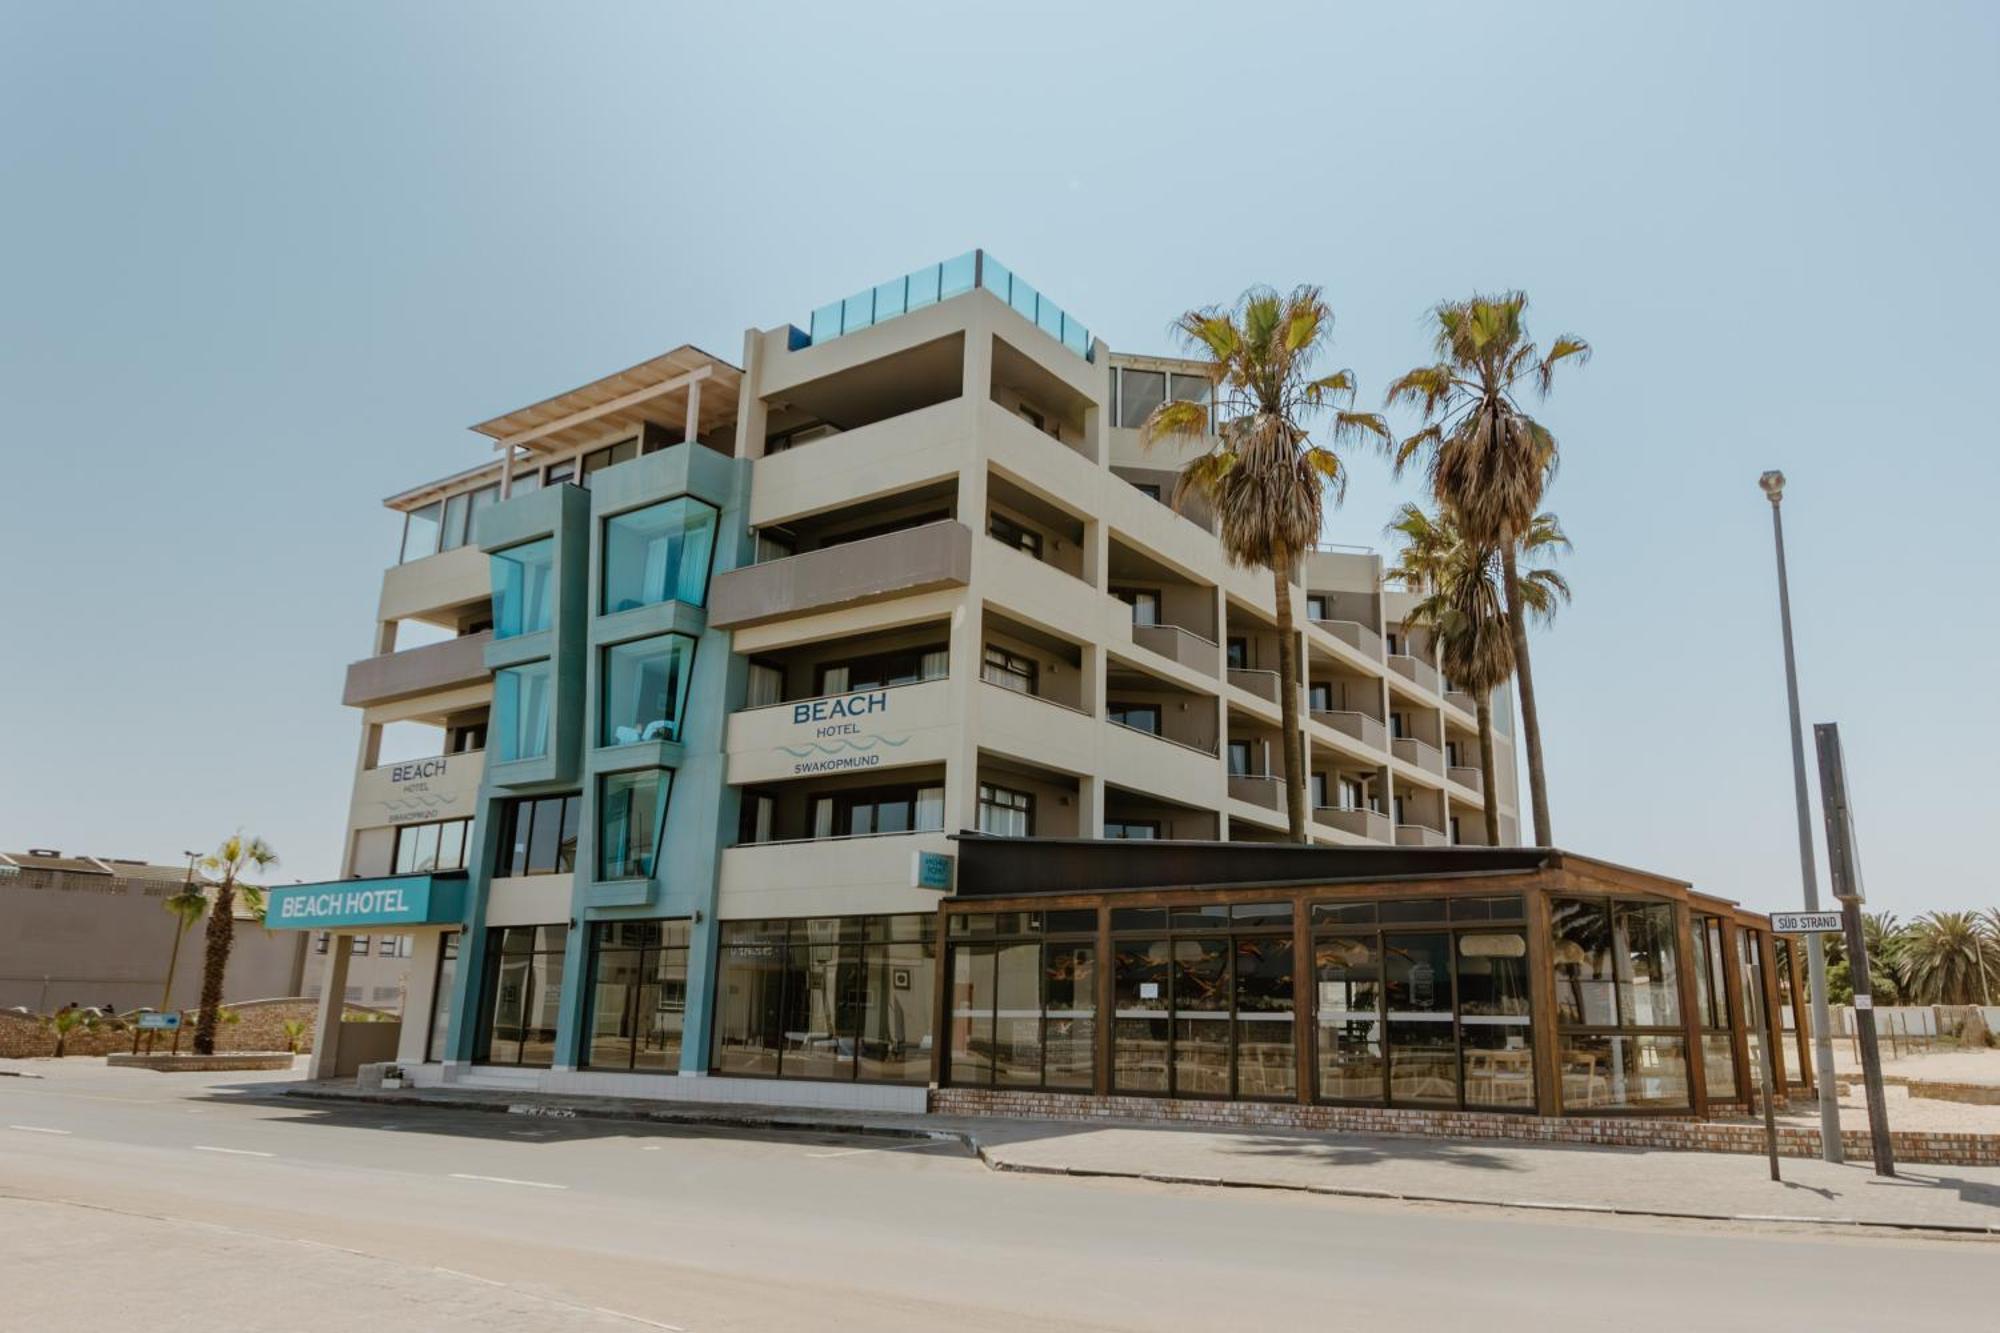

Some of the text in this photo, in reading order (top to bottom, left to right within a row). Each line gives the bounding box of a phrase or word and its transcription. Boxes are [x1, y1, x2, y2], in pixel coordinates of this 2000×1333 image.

[793, 692, 887, 725] BEACH
[816, 723, 861, 738] HOTEL
[392, 759, 447, 783] BEACH
[794, 755, 880, 774] SWAKOPMUND
[281, 889, 409, 918] BEACH HOTEL
[1778, 915, 1837, 929] SÜD STRAND
